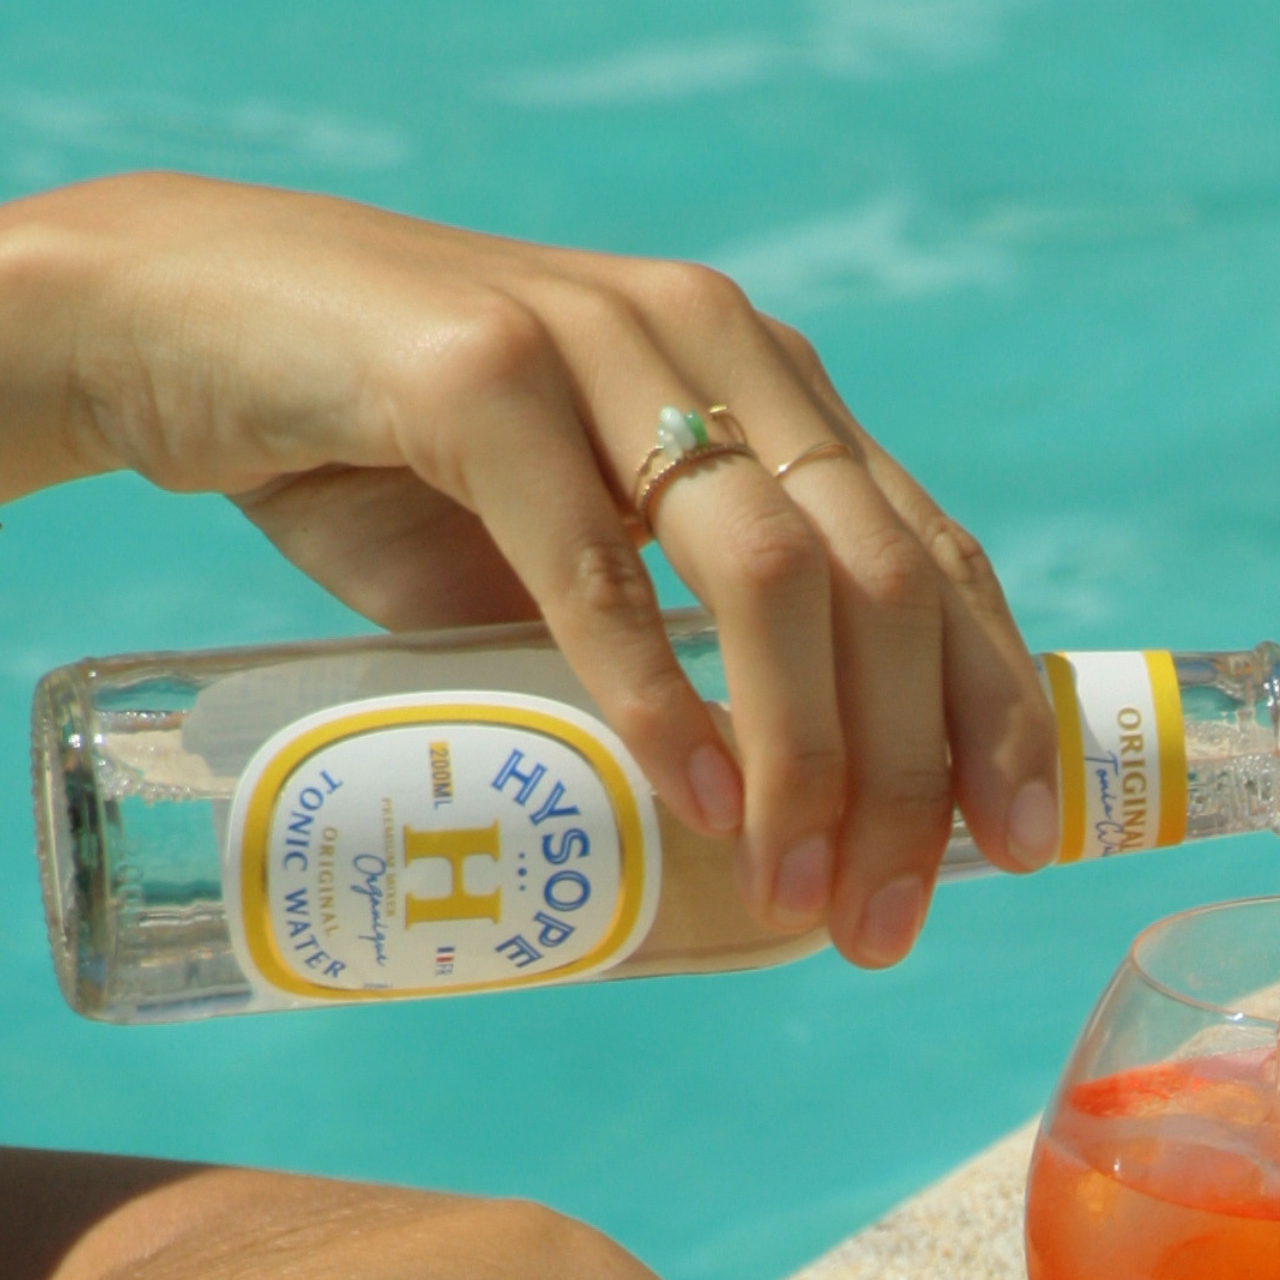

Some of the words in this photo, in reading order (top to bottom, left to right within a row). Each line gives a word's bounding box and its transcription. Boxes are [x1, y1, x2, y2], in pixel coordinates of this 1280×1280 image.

[283, 770, 344, 872] TONIC
[381, 797, 396, 867] PREMIUM
[429, 748, 454, 810] 200ML
[1117, 707, 1147, 851] ORIGINAL
[317, 826, 340, 938] ORIGINAL
[351, 854, 390, 968] Organique
[385, 874, 397, 918] MIXER
[403, 818, 501, 931] H
[491, 748, 592, 969] HYSOPE
[284, 891, 347, 979] WATER
